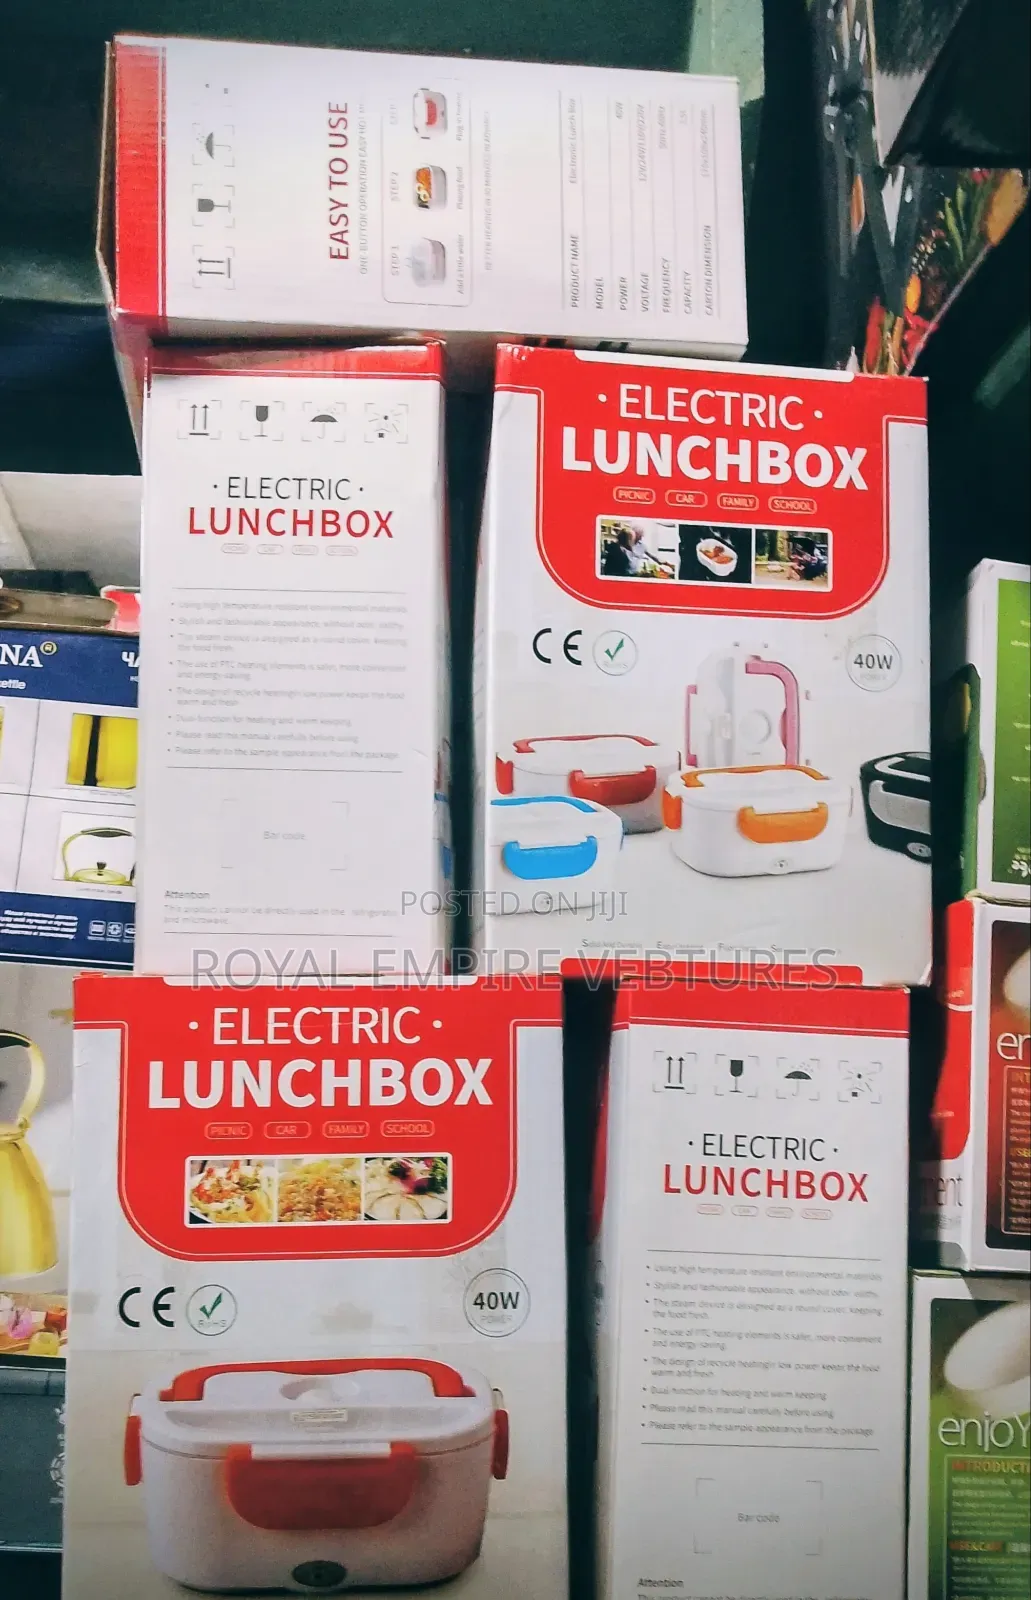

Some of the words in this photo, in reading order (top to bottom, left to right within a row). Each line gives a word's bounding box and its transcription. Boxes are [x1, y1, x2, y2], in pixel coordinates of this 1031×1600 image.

[328, 101, 348, 148] USE
[328, 157, 348, 191] TO
[358, 159, 368, 212] OPERATION
[390, 177, 399, 202] STEP
[328, 198, 350, 260] EASY
[570, 234, 579, 261] NAME
[390, 252, 399, 276] STEP
[703, 224, 713, 277] DIMENSION
[571, 262, 580, 308] PRODUCT
[595, 276, 604, 310] MODEL
[619, 276, 628, 311] POWER
[640, 272, 650, 313] VOLTAGE
[661, 256, 671, 314] FREQUENCY
[683, 270, 692, 315] CAPACITY
[704, 278, 713, 317] CARTON
[619, 383, 804, 431] ELECTRIC
[562, 427, 868, 491] LUNCHBOX
[227, 476, 351, 501] ELECTRIC
[617, 488, 651, 502] PICNIC
[675, 493, 696, 504] CAR
[722, 495, 755, 509] FAMILY
[773, 498, 814, 512] SCHOOL
[188, 507, 393, 538] LUNCHBOX
[532, 627, 583, 666] CE
[853, 653, 893, 670] 40W
[213, 1006, 421, 1045] ELECTRIC
[149, 1058, 494, 1109] LUNCHBOX
[210, 1125, 247, 1136] PICNIC
[275, 1124, 297, 1136] CAR
[328, 1123, 365, 1136] FAMILY
[386, 1122, 430, 1135] SCHOOL
[703, 1132, 826, 1162] ELECTRIC
[664, 1164, 869, 1202] LUNCHBOX
[119, 1286, 176, 1328] CE
[473, 1291, 520, 1310] 40W
[637, 1577, 685, 1588] Attention
